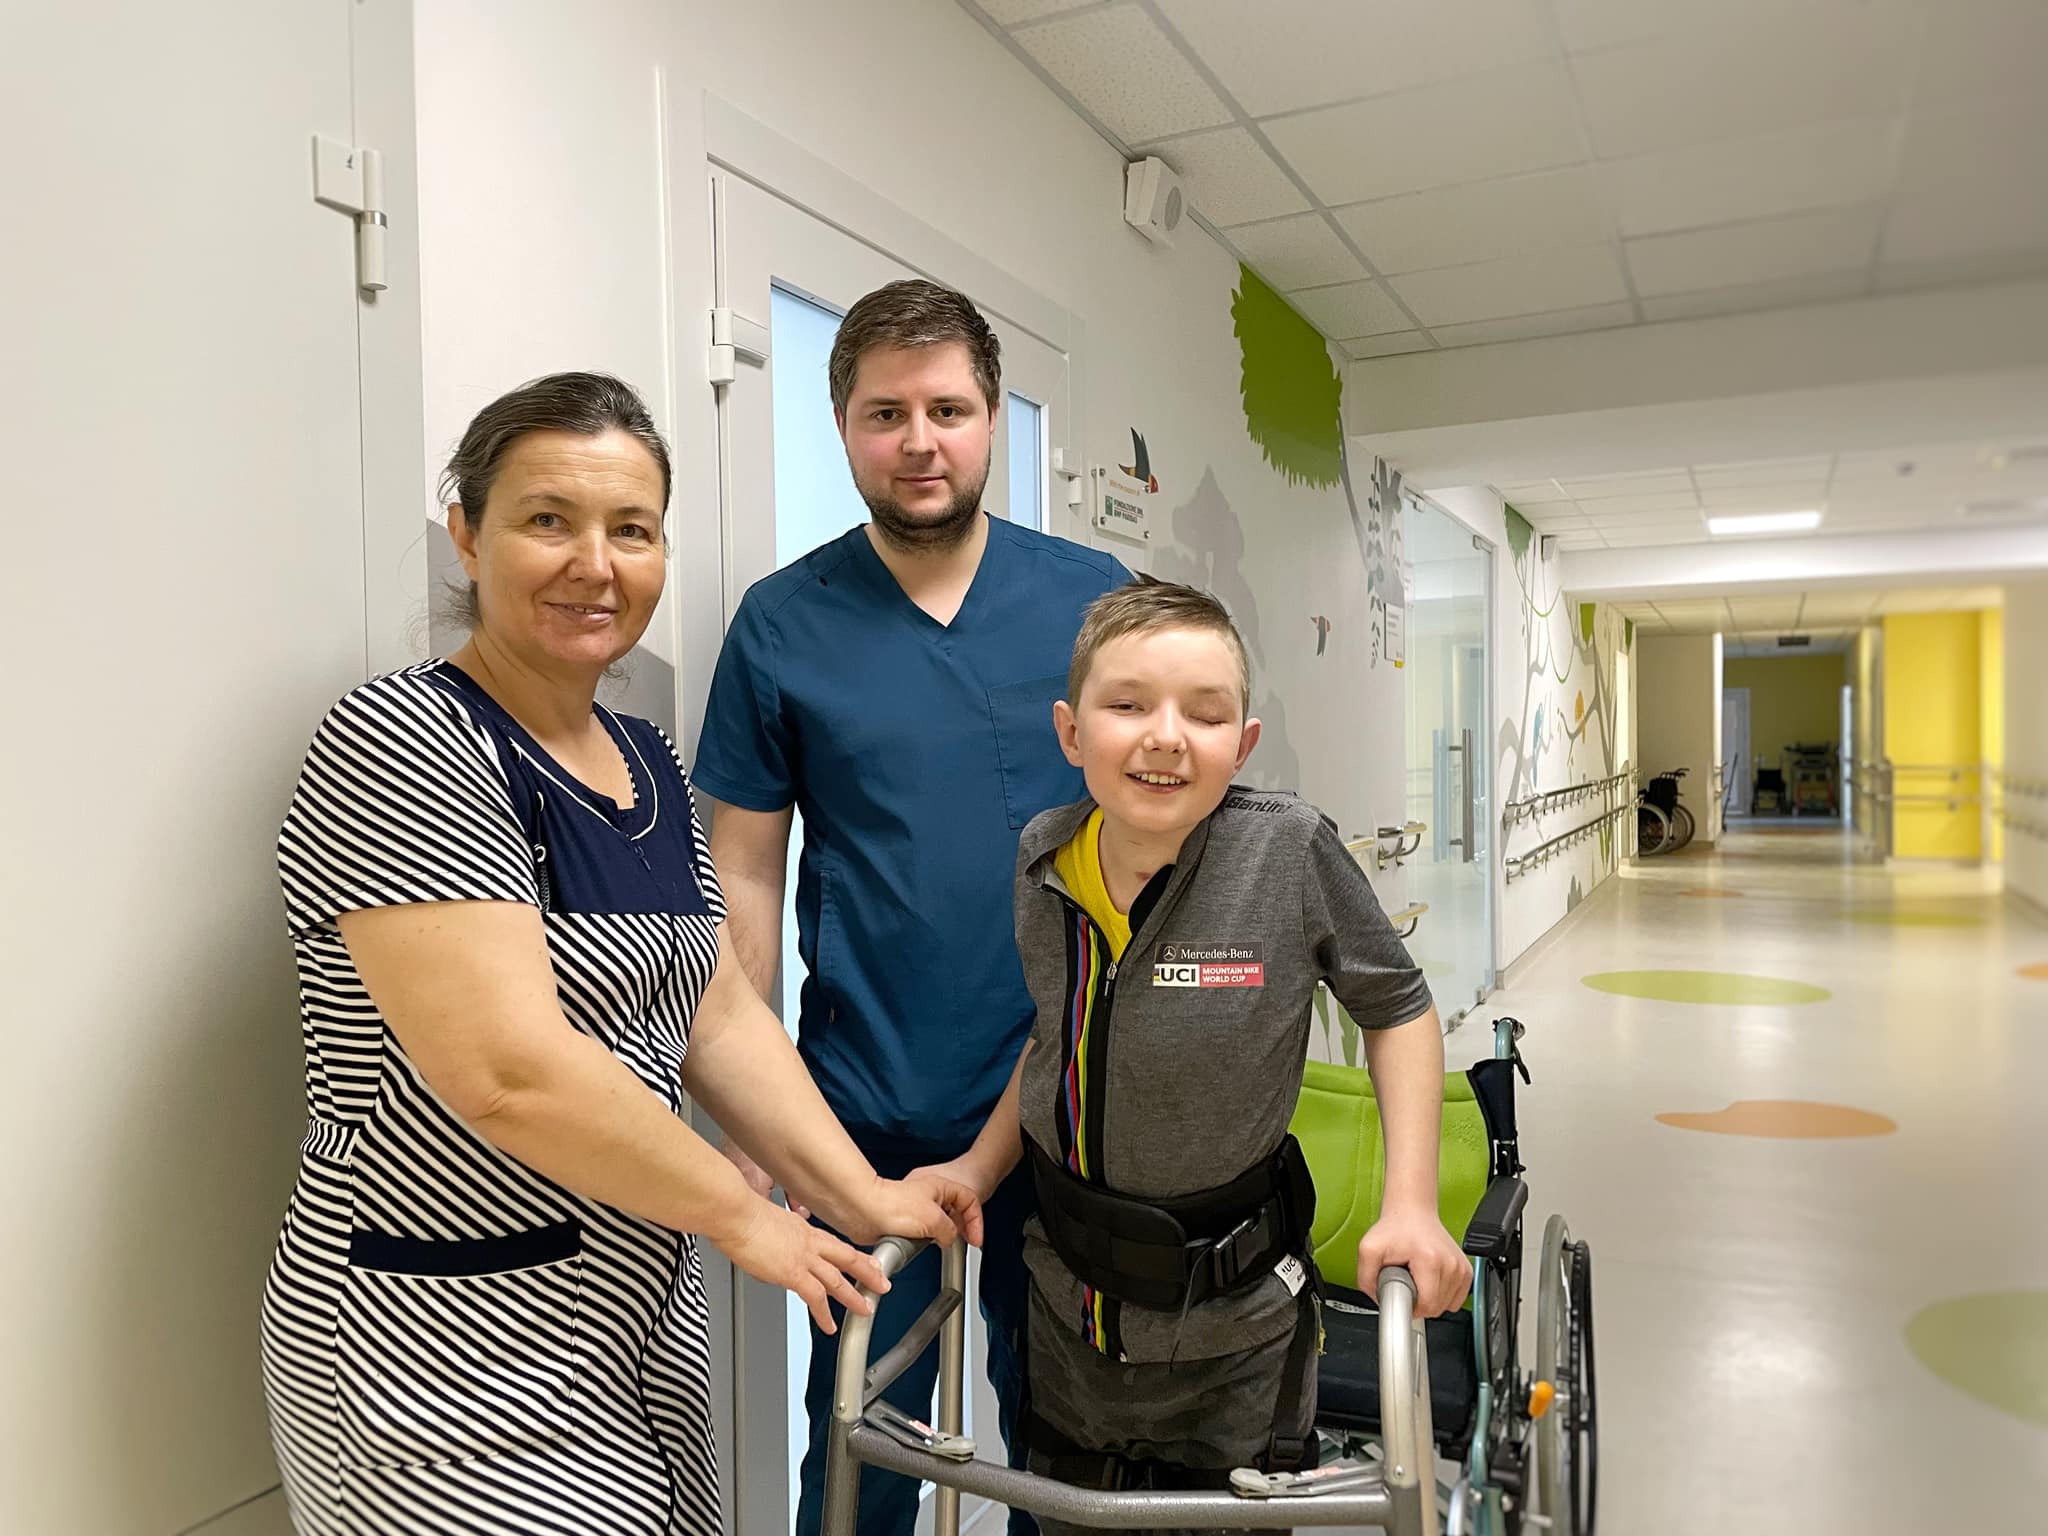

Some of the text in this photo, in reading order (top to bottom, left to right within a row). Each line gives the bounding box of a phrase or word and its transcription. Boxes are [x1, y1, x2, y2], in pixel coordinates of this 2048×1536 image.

[1181, 948, 1254, 960] Mercedes-Benz
[1160, 968, 1196, 982] UCI
[1244, 966, 1260, 974] BIKE
[1202, 976, 1228, 984] WORLD
